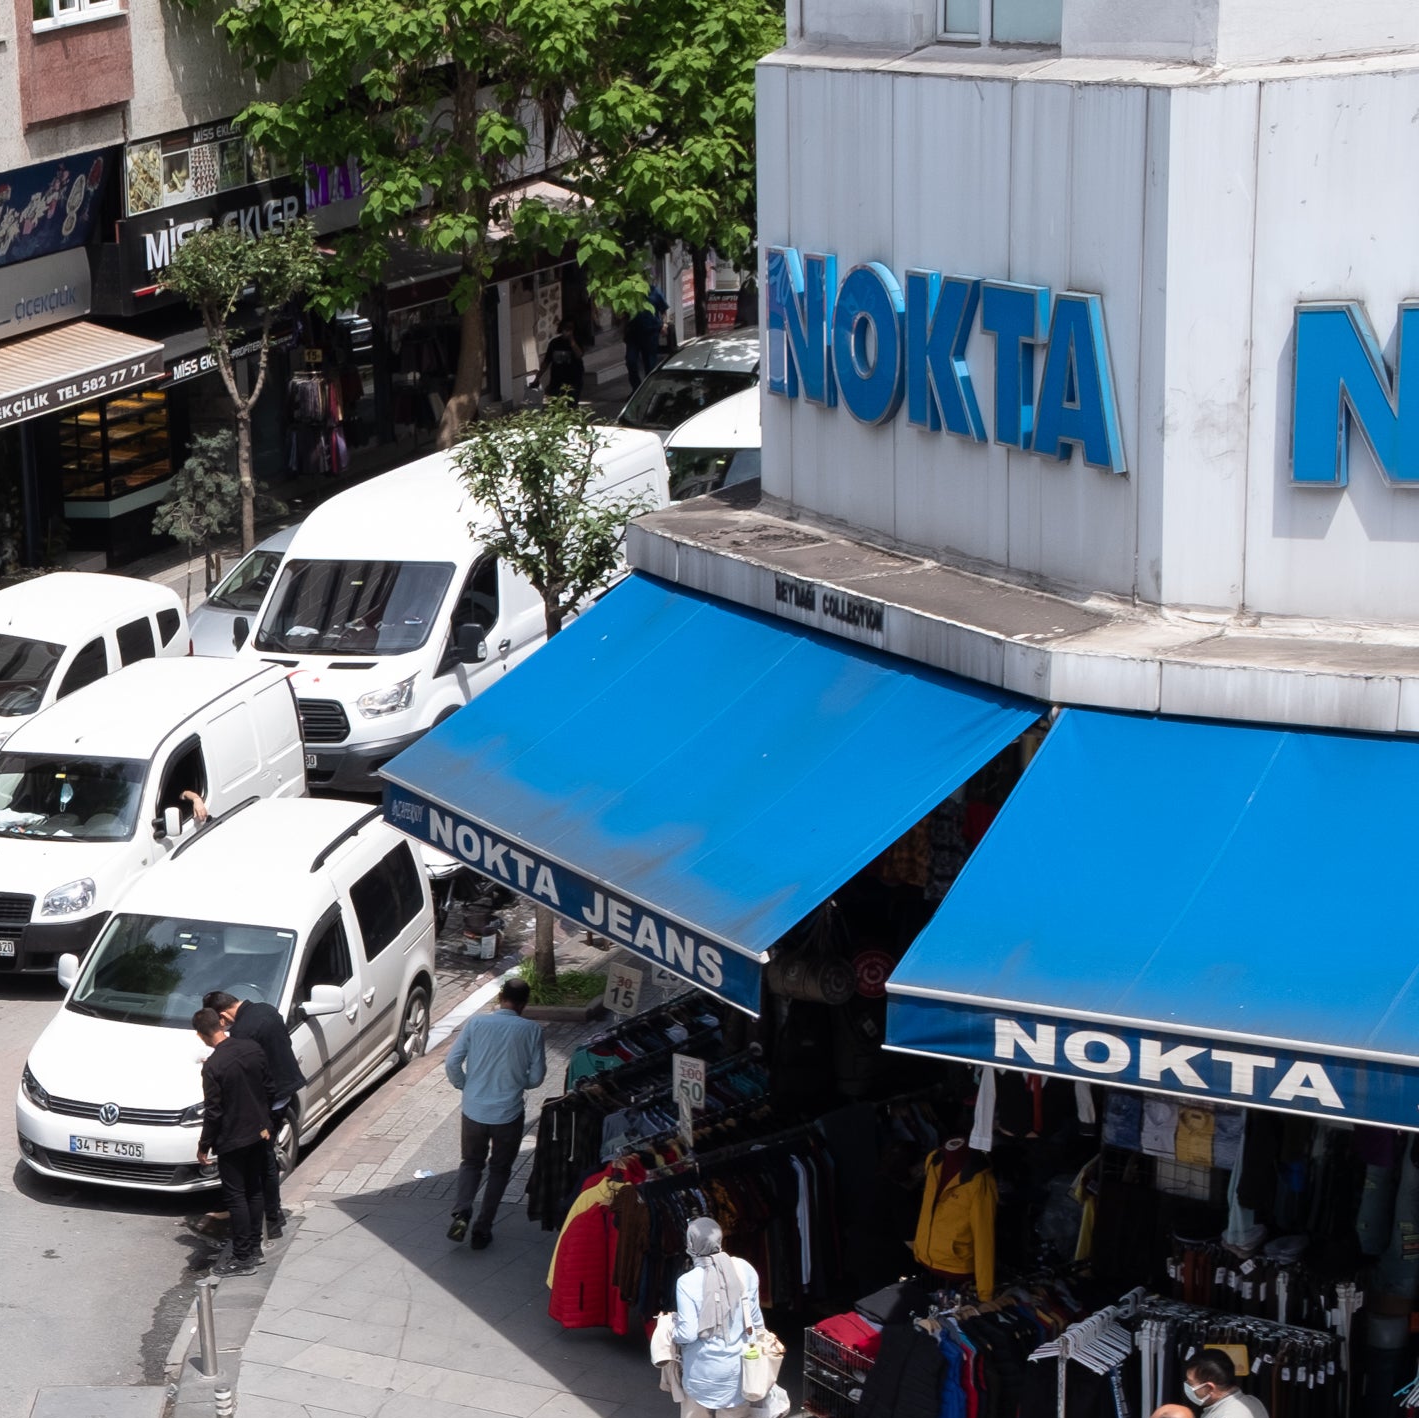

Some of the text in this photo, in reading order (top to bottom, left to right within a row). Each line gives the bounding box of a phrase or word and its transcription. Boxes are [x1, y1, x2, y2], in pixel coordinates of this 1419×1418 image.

[765, 246, 1128, 474] NOKTA
[57, 387, 80, 402] TEL
[82, 377, 107, 395] 582
[110, 369, 128, 386] 77
[131, 361, 147, 377] 71
[823, 592, 883, 632] COLLECTION
[429, 807, 724, 988] NOKTA JEANS
[610, 987, 636, 1009] 15
[617, 976, 633, 989] 30
[680, 1066, 704, 1081] 100
[994, 1018, 1346, 1110] NOKTA
[679, 1079, 704, 1102] 50
[75, 1138, 143, 1159] 34 FE 4505
